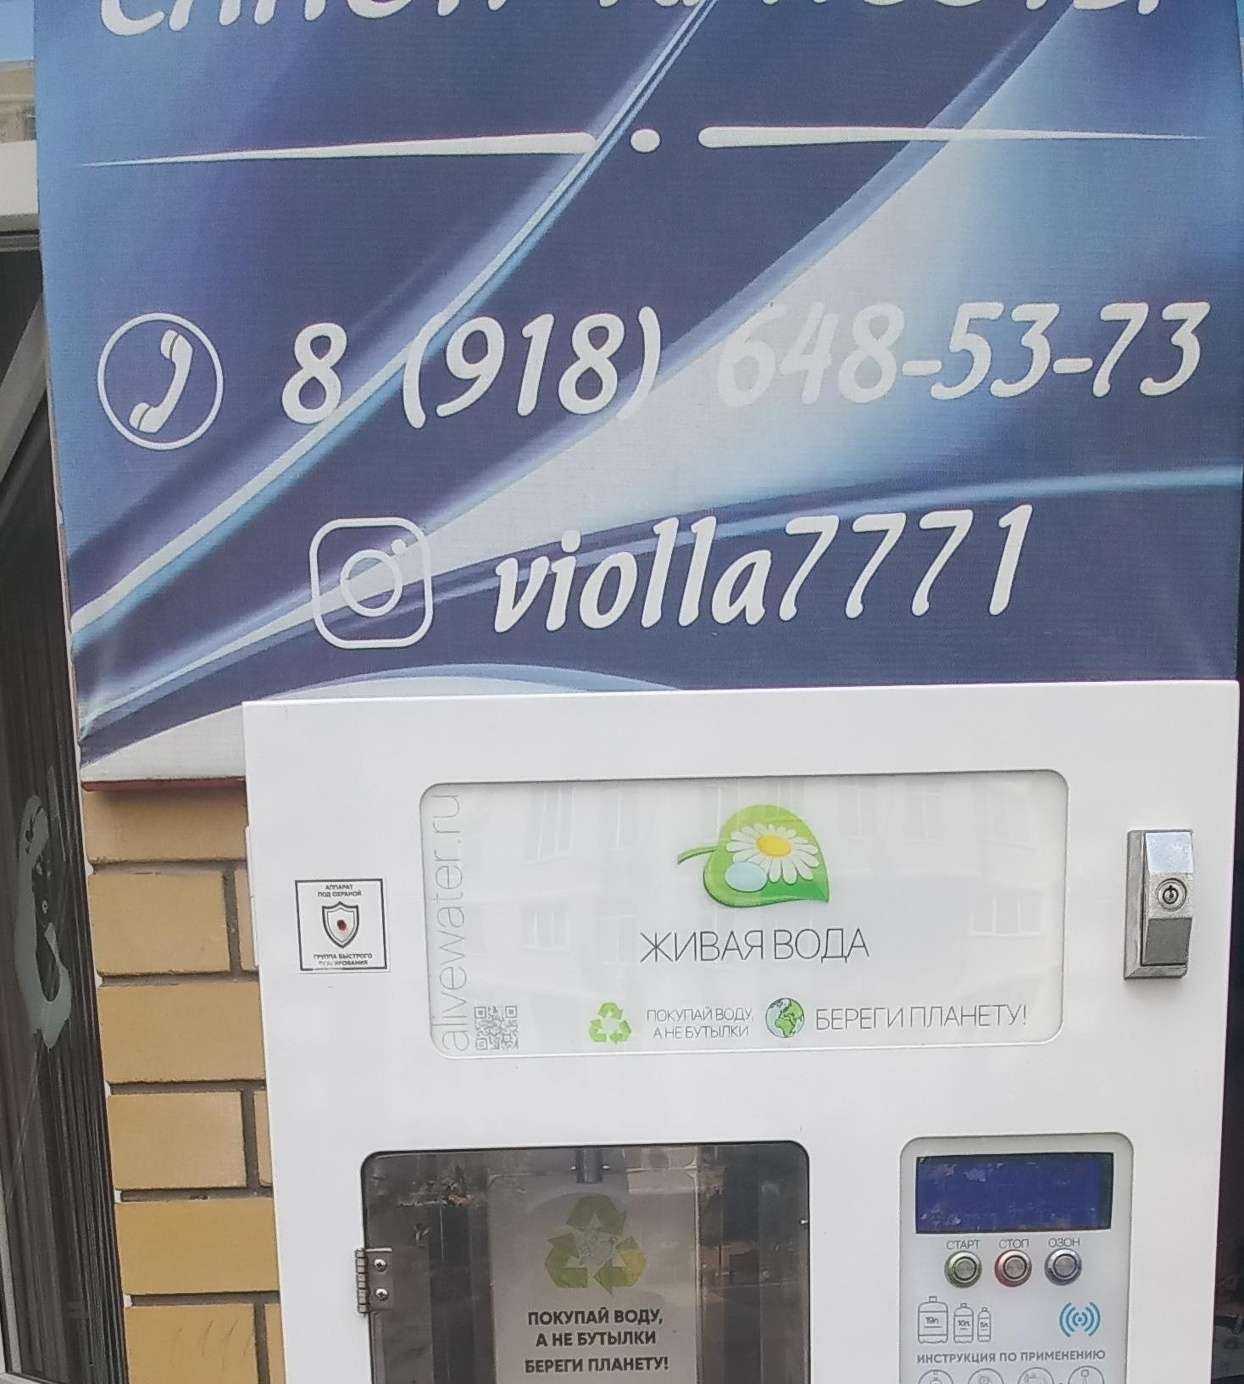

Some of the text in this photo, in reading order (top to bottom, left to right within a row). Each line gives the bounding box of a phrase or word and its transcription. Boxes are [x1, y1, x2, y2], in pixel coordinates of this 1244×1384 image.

[281, 300, 1211, 429] 8 (918) 648-53-73
[493, 503, 1034, 634] violla7771
[431, 793, 471, 1052] alivewater.ru
[639, 928, 870, 963] ЖИВАЯ ВОДА
[646, 1006, 714, 1023] ПОКУПАЙ
[816, 1004, 1027, 1031] БЕРЕГИ ПЛАНЕТУ!
[653, 1026, 749, 1040] А НЕ БУТЫЛКИ
[946, 1239, 981, 1250] СТАРТ
[998, 1238, 1030, 1249] СТОП
[1048, 1237, 1081, 1248] ОЗОН
[528, 1308, 663, 1326] ПОКУПАЙ ВОДУ,
[535, 1330, 656, 1348] А НЕ БУТЫЛКИ
[525, 1356, 669, 1374] БЕРЕГИ ПЛАНЕТУ!
[916, 1350, 1106, 1364] ИНСТРУКЦИЯ ПО ПРИМЕНЕНИЮ
